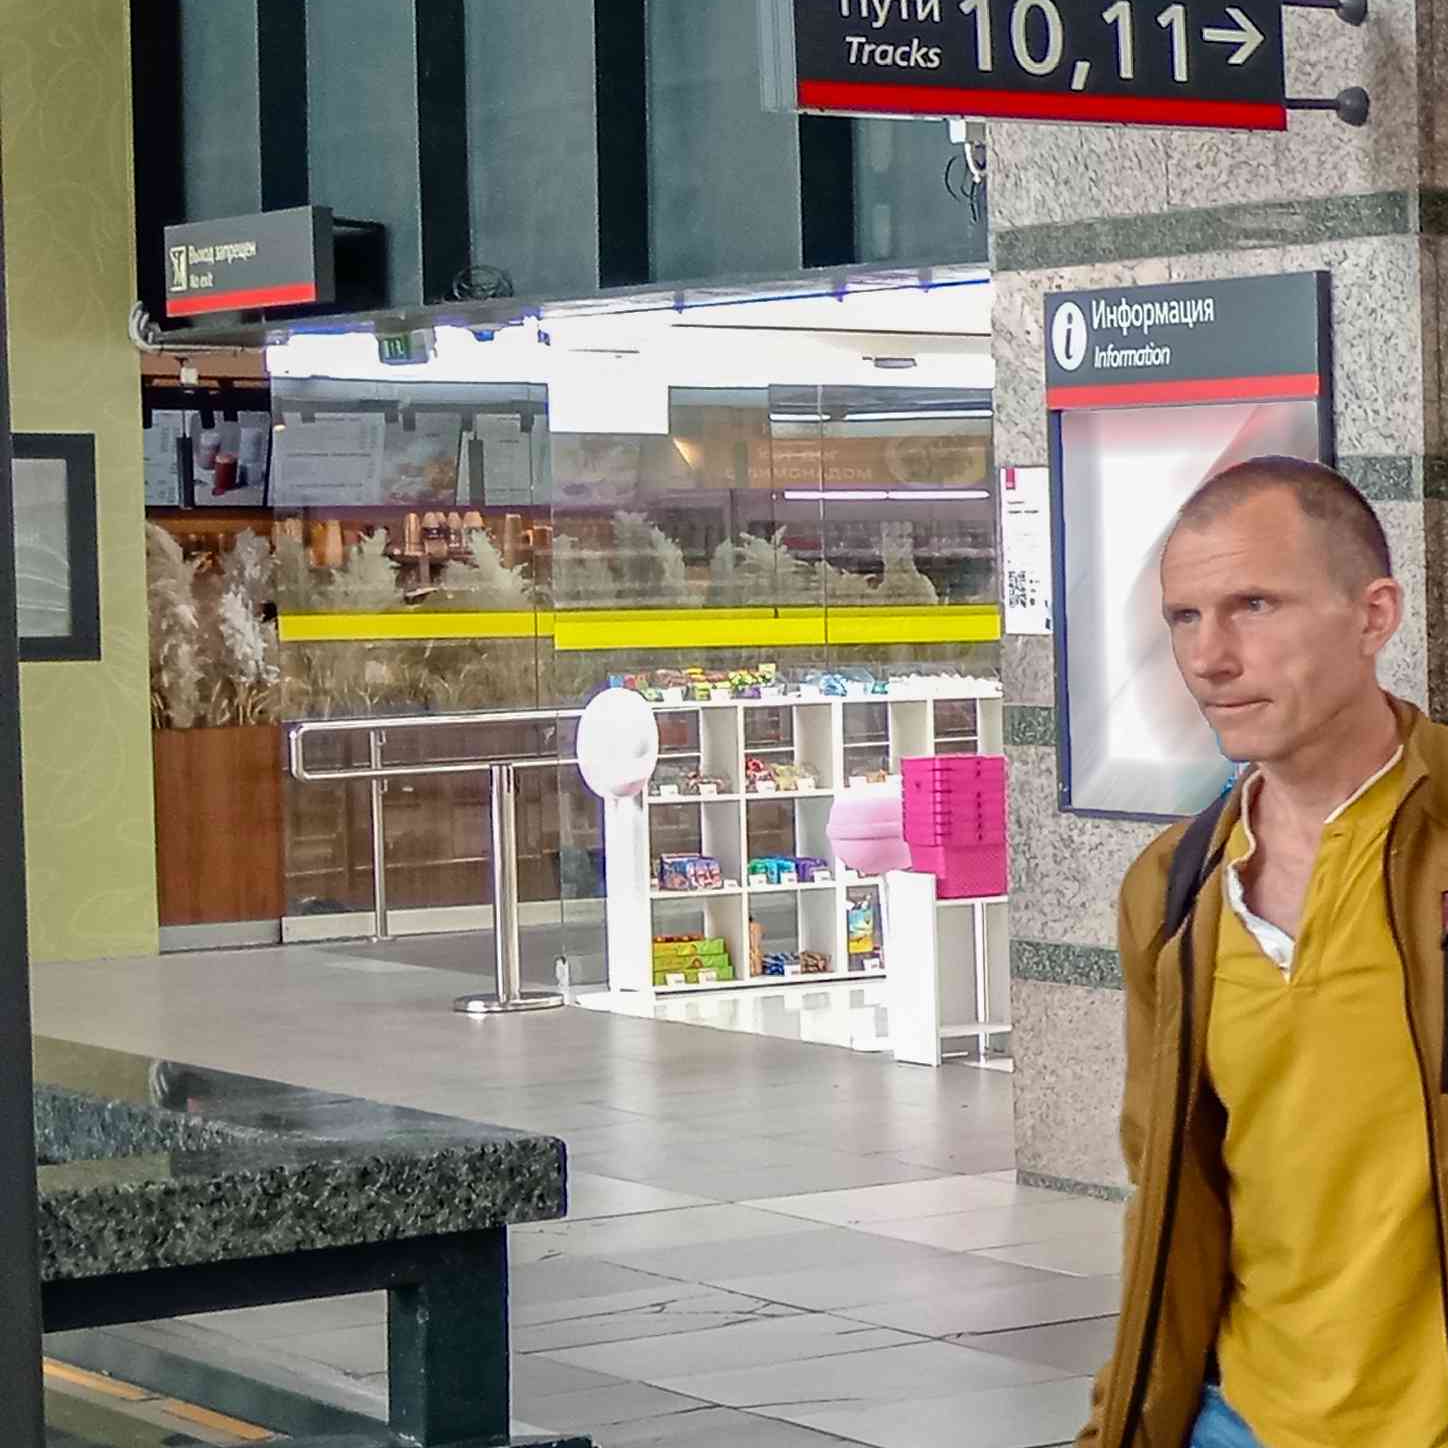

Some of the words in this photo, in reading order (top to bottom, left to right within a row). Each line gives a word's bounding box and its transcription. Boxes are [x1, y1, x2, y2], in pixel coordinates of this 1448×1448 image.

[845, 36, 941, 68] Tracks
[1091, 297, 1214, 335] Информация
[1094, 342, 1170, 369] Information
